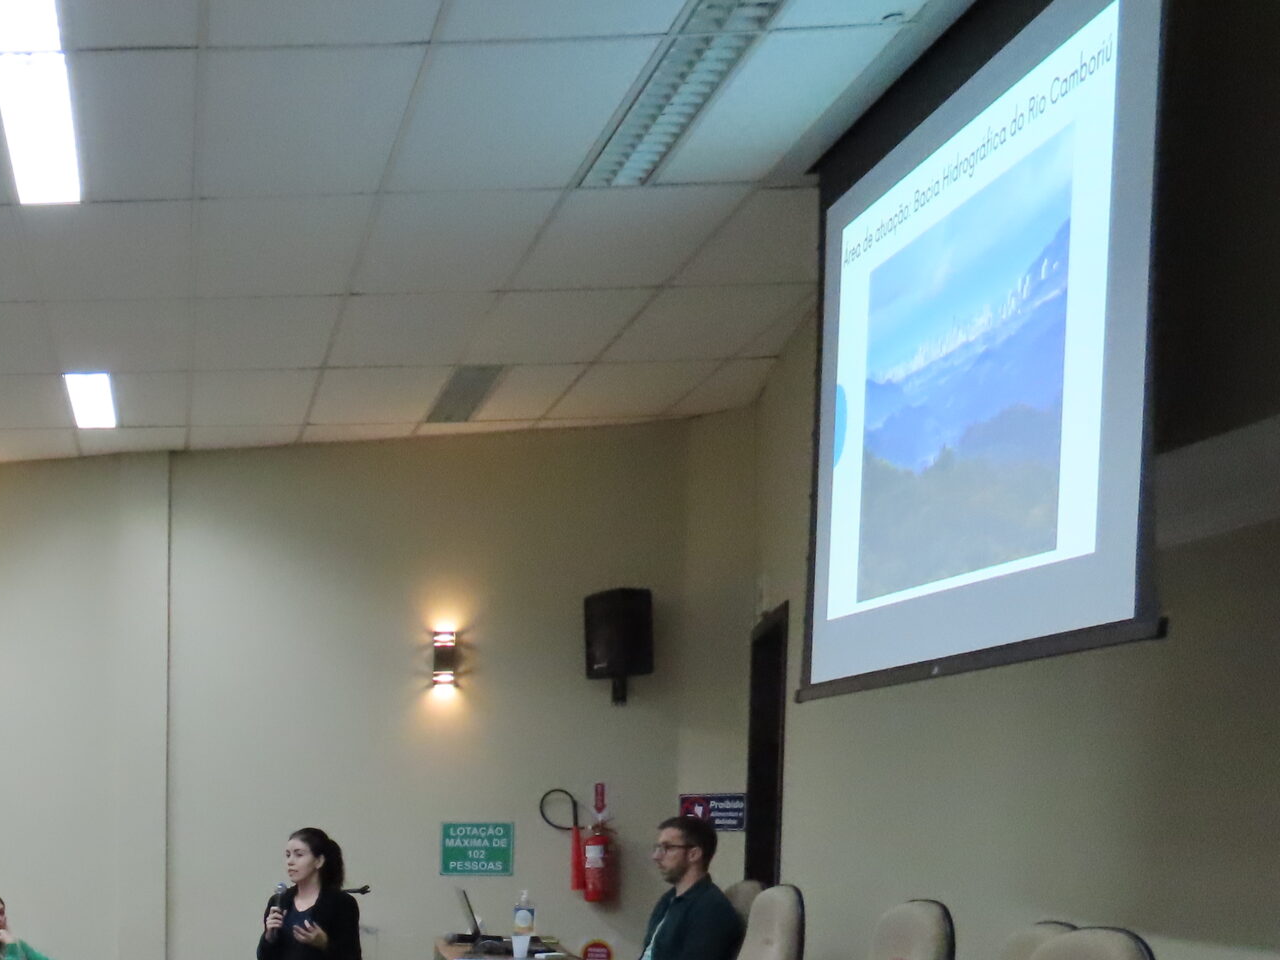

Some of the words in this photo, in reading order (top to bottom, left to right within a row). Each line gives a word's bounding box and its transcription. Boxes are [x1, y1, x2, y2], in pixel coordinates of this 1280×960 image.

[863, 225, 873, 252] de
[914, 180, 939, 212] Bacia
[942, 126, 1007, 190] Hidrográfica
[1010, 104, 1024, 136] do
[1028, 94, 1046, 123] Rio
[1050, 33, 1113, 104] Camboriú
[709, 800, 744, 808] Proibido
[449, 825, 504, 838] LOTAÇÃO
[445, 836, 490, 848] MÁXIMA
[492, 838, 507, 848] DE
[468, 850, 485, 859] 102
[449, 861, 503, 871] PESSOAS
